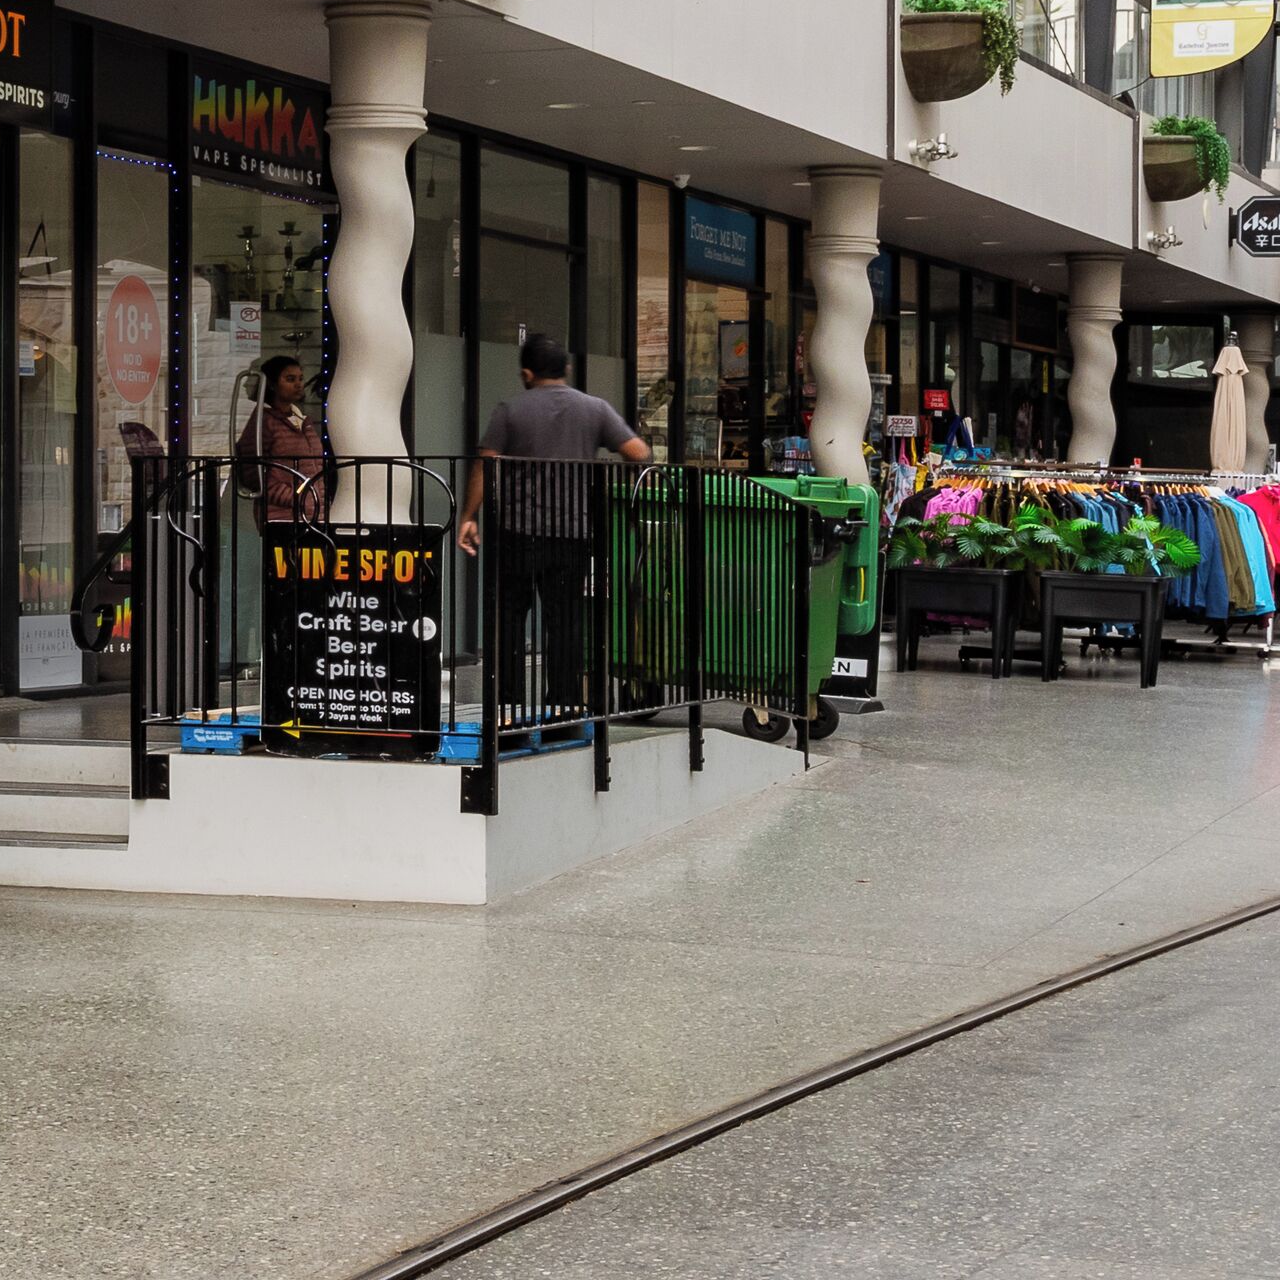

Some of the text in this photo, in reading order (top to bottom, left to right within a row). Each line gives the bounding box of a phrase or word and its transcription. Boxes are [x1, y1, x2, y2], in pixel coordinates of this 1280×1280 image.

[192, 145, 322, 186] VAPE SPECIALIST
[1243, 212, 1280, 231] Asa
[689, 215, 747, 252] FORGET ME NOT
[114, 302, 153, 345] 18+
[123, 353, 143, 366] NO ID
[116, 369, 151, 383] NO ENTRY
[274, 546, 433, 583] WINE SPOT
[327, 592, 380, 610] Wine
[297, 612, 408, 634] Craft Beer
[327, 636, 377, 656] Beer
[315, 657, 387, 680] Spirits
[286, 686, 415, 704] OPENING HOURS:
[327, 711, 349, 723] Days
